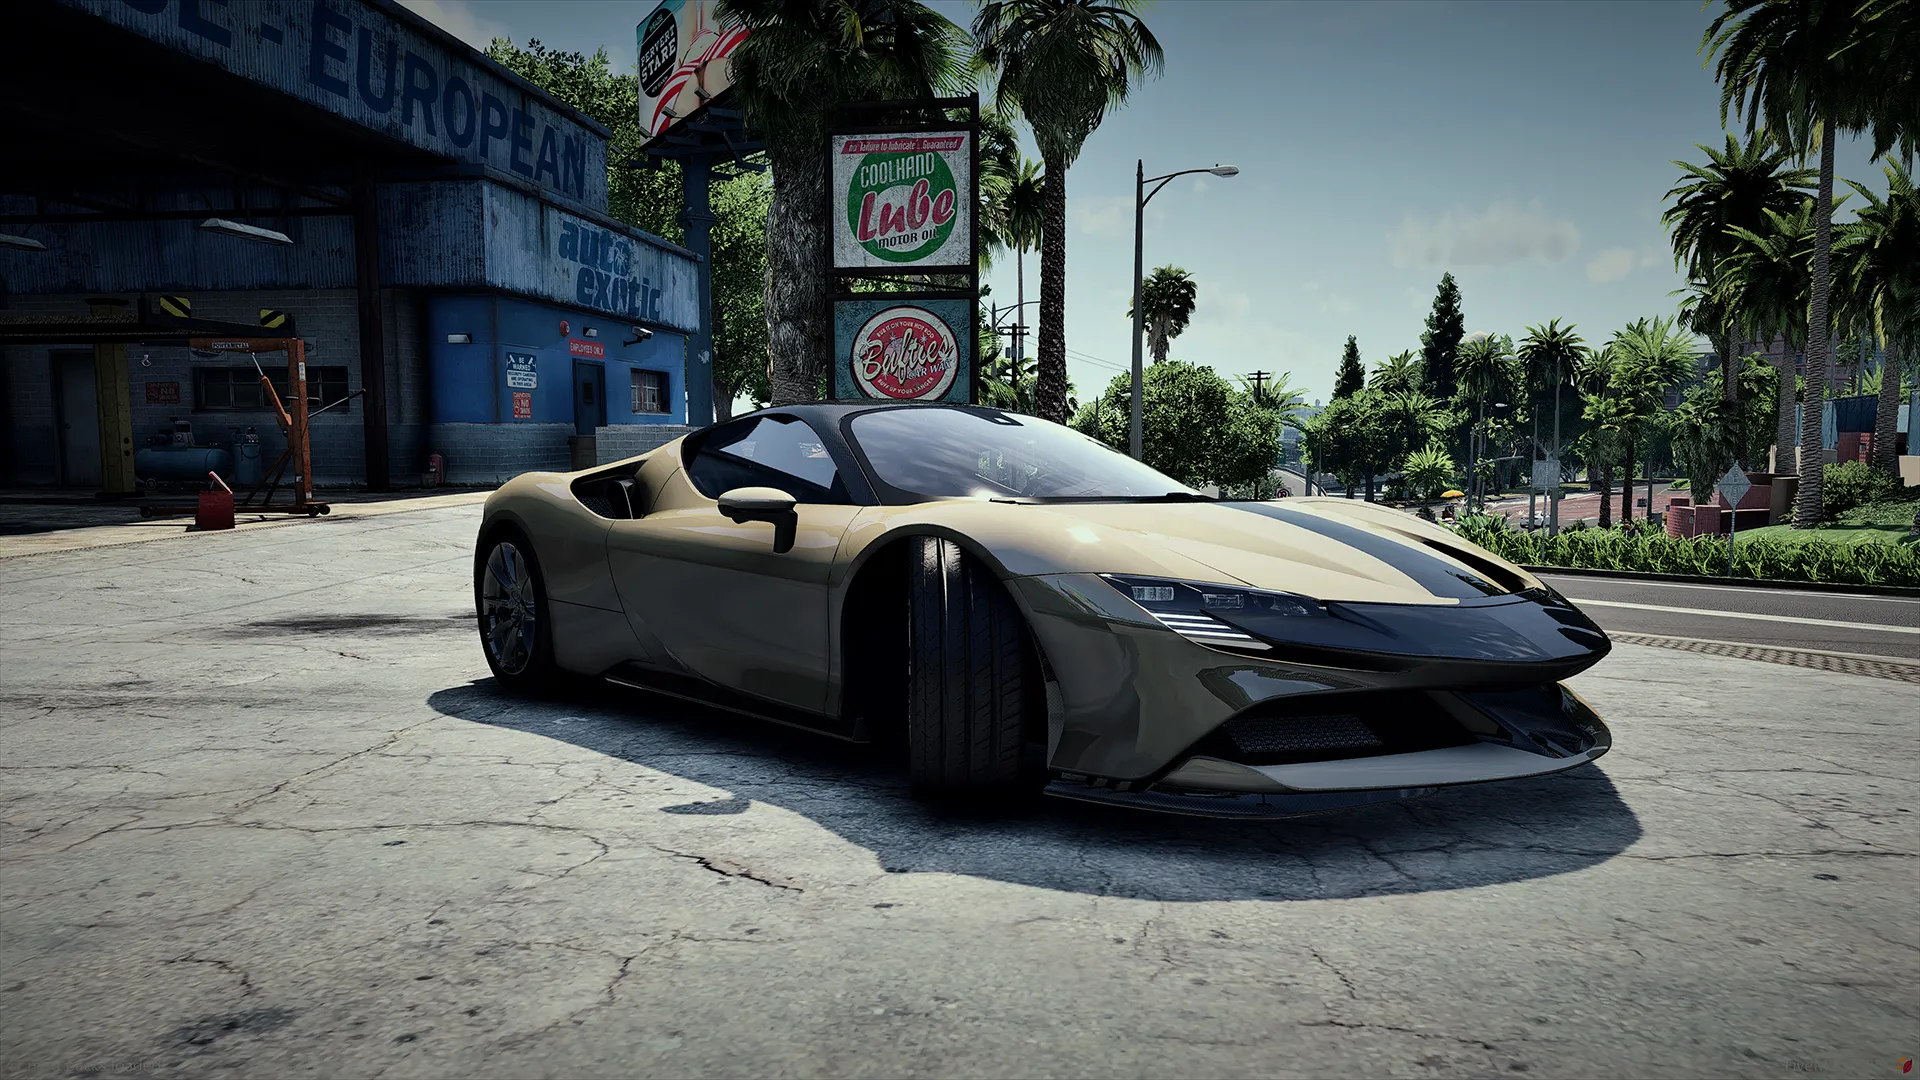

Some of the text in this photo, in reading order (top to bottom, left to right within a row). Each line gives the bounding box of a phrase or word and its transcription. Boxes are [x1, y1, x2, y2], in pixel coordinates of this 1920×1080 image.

[641, 23, 675, 67] PERVERT
[641, 36, 676, 84] STARE
[309, 1, 586, 200] EUROPEAN
[860, 152, 935, 188] COOLHAND
[858, 178, 955, 242] Lube
[558, 220, 631, 276] auto
[878, 228, 938, 249] MOTOR OIL
[576, 267, 661, 321] exotic
[570, 342, 604, 355] EMPLOYEES ONLY
[521, 399, 530, 408] NO
